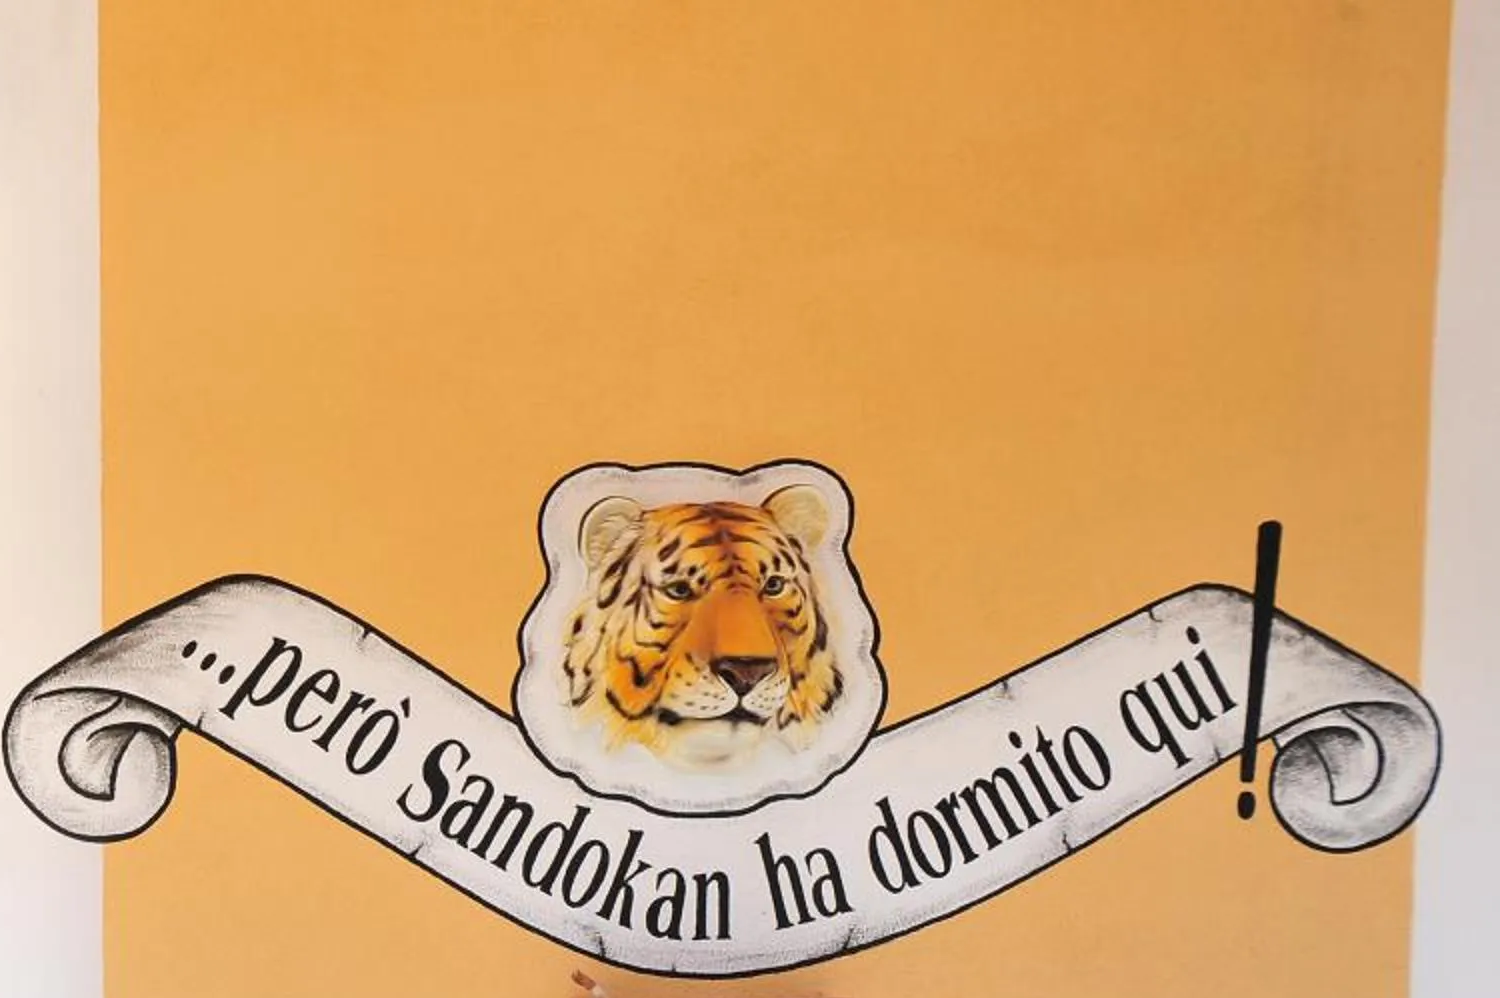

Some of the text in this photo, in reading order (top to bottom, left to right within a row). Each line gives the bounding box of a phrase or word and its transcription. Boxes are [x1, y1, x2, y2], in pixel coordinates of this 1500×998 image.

[397, 738, 732, 942] Sandokan
[754, 831, 854, 931] ha
[867, 723, 1113, 895] dormito
